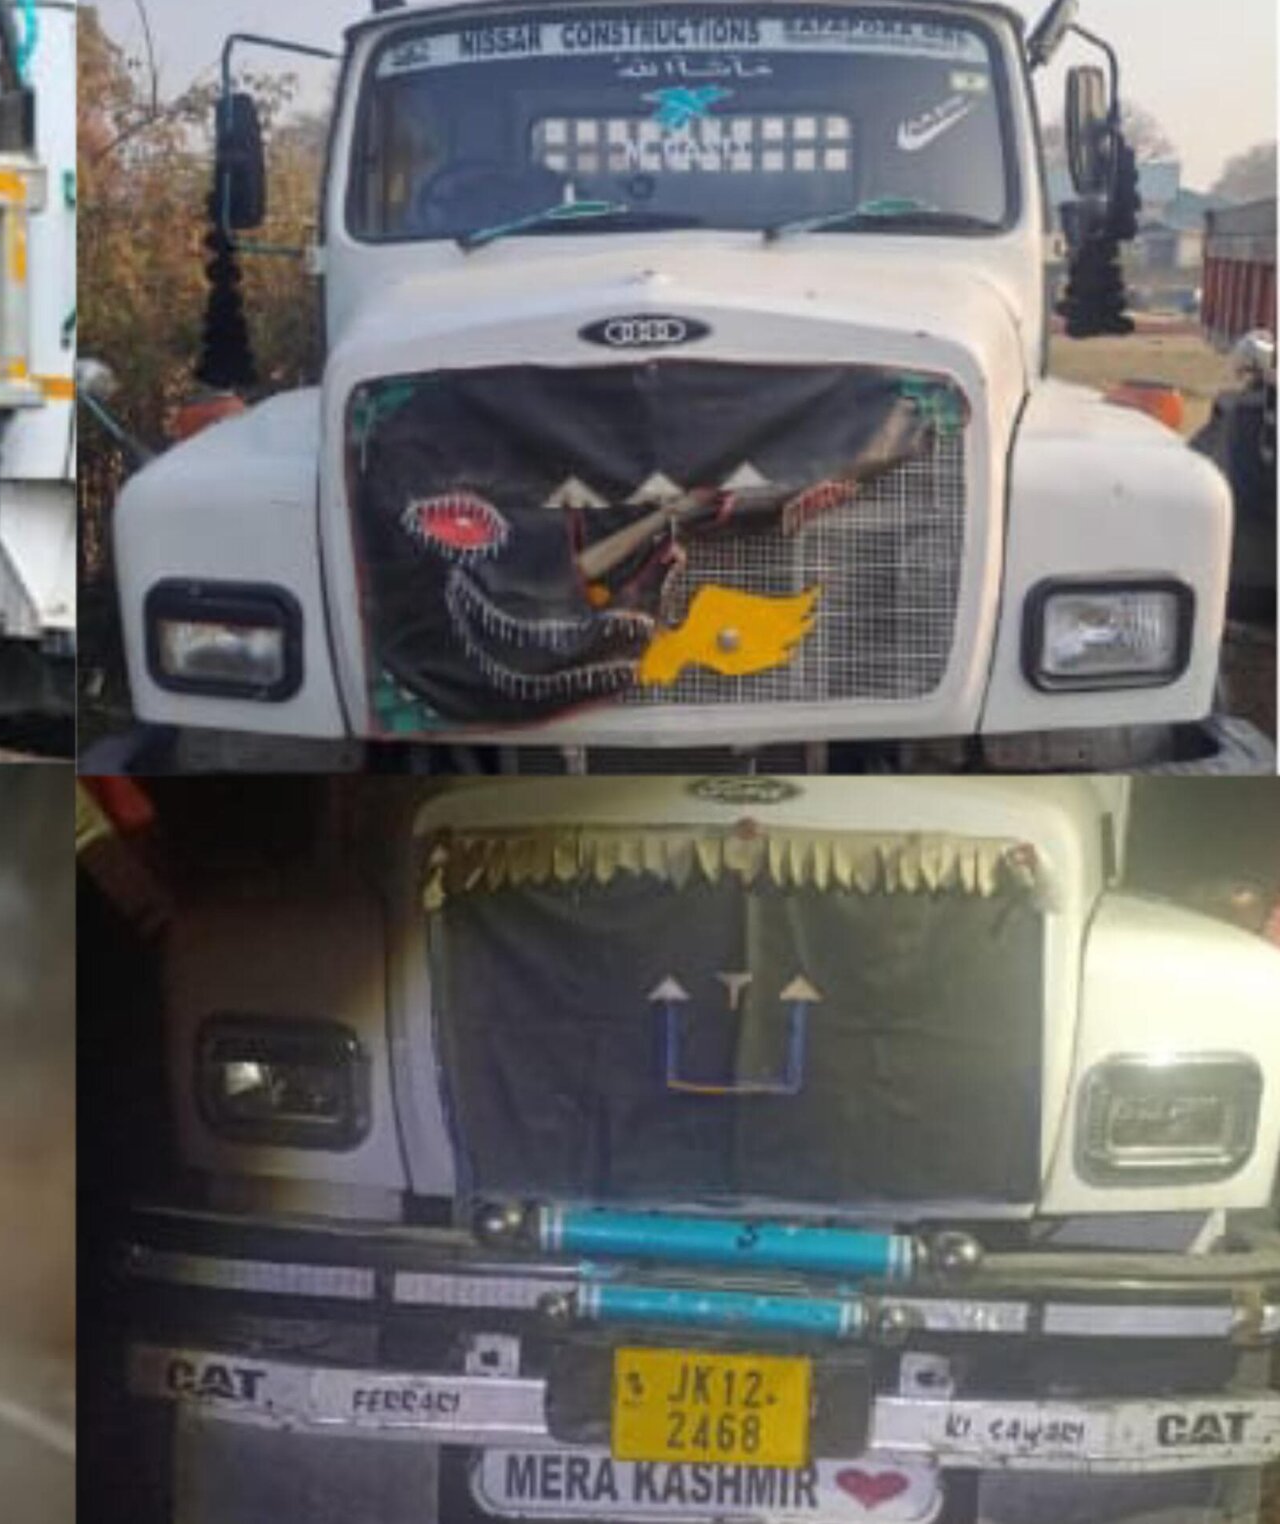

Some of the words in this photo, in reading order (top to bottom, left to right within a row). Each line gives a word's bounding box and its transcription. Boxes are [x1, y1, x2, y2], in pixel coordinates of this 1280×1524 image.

[562, 18, 760, 49] CONSTRUCTIONS
[666, 1410, 761, 1455] 2468
[505, 1454, 618, 1501] MERA
[632, 1460, 818, 1508] KASHMIR
